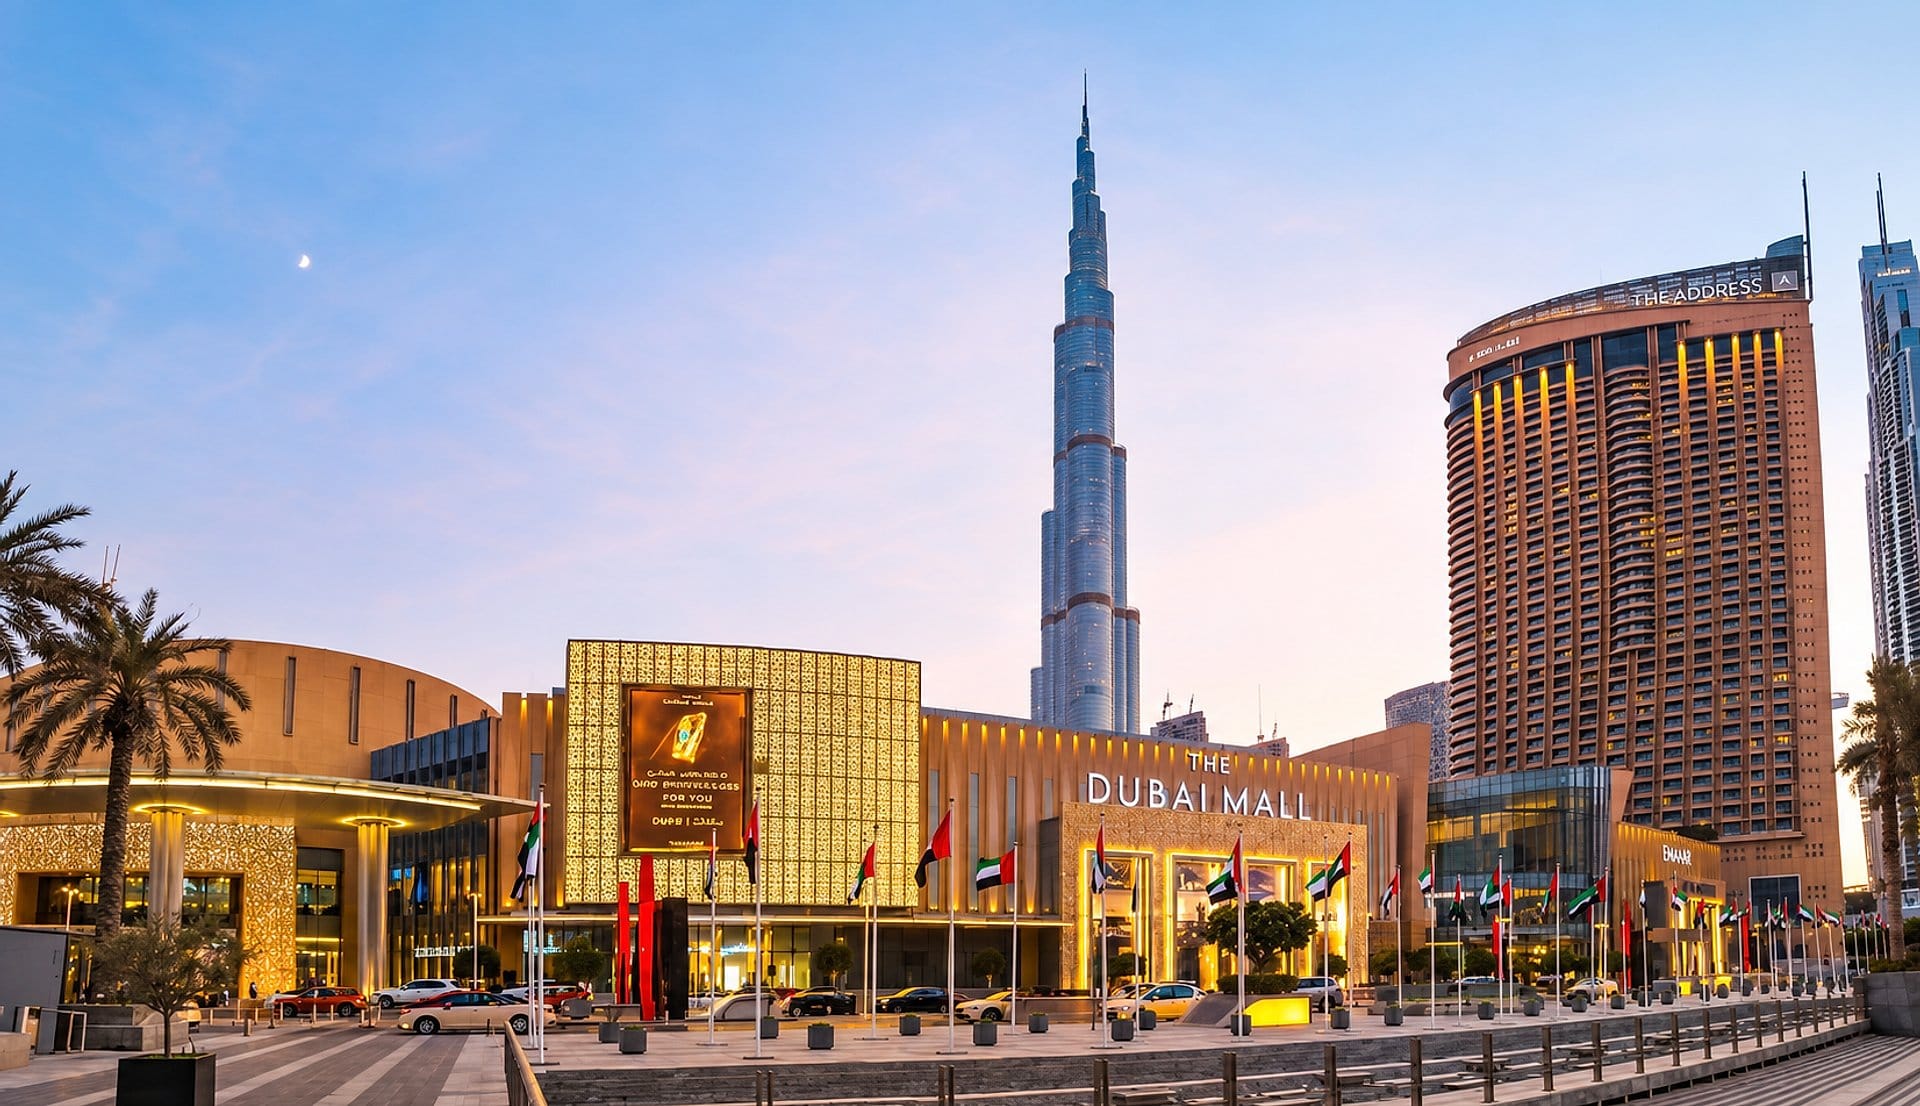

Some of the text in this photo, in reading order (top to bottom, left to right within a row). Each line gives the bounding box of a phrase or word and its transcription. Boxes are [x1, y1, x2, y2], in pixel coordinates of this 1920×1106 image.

[1630, 277, 1762, 307] THE ADDRESS
[1187, 752, 1230, 775] THE
[689, 794, 713, 803] YOU
[1087, 772, 1312, 821] DUBAI MALL
